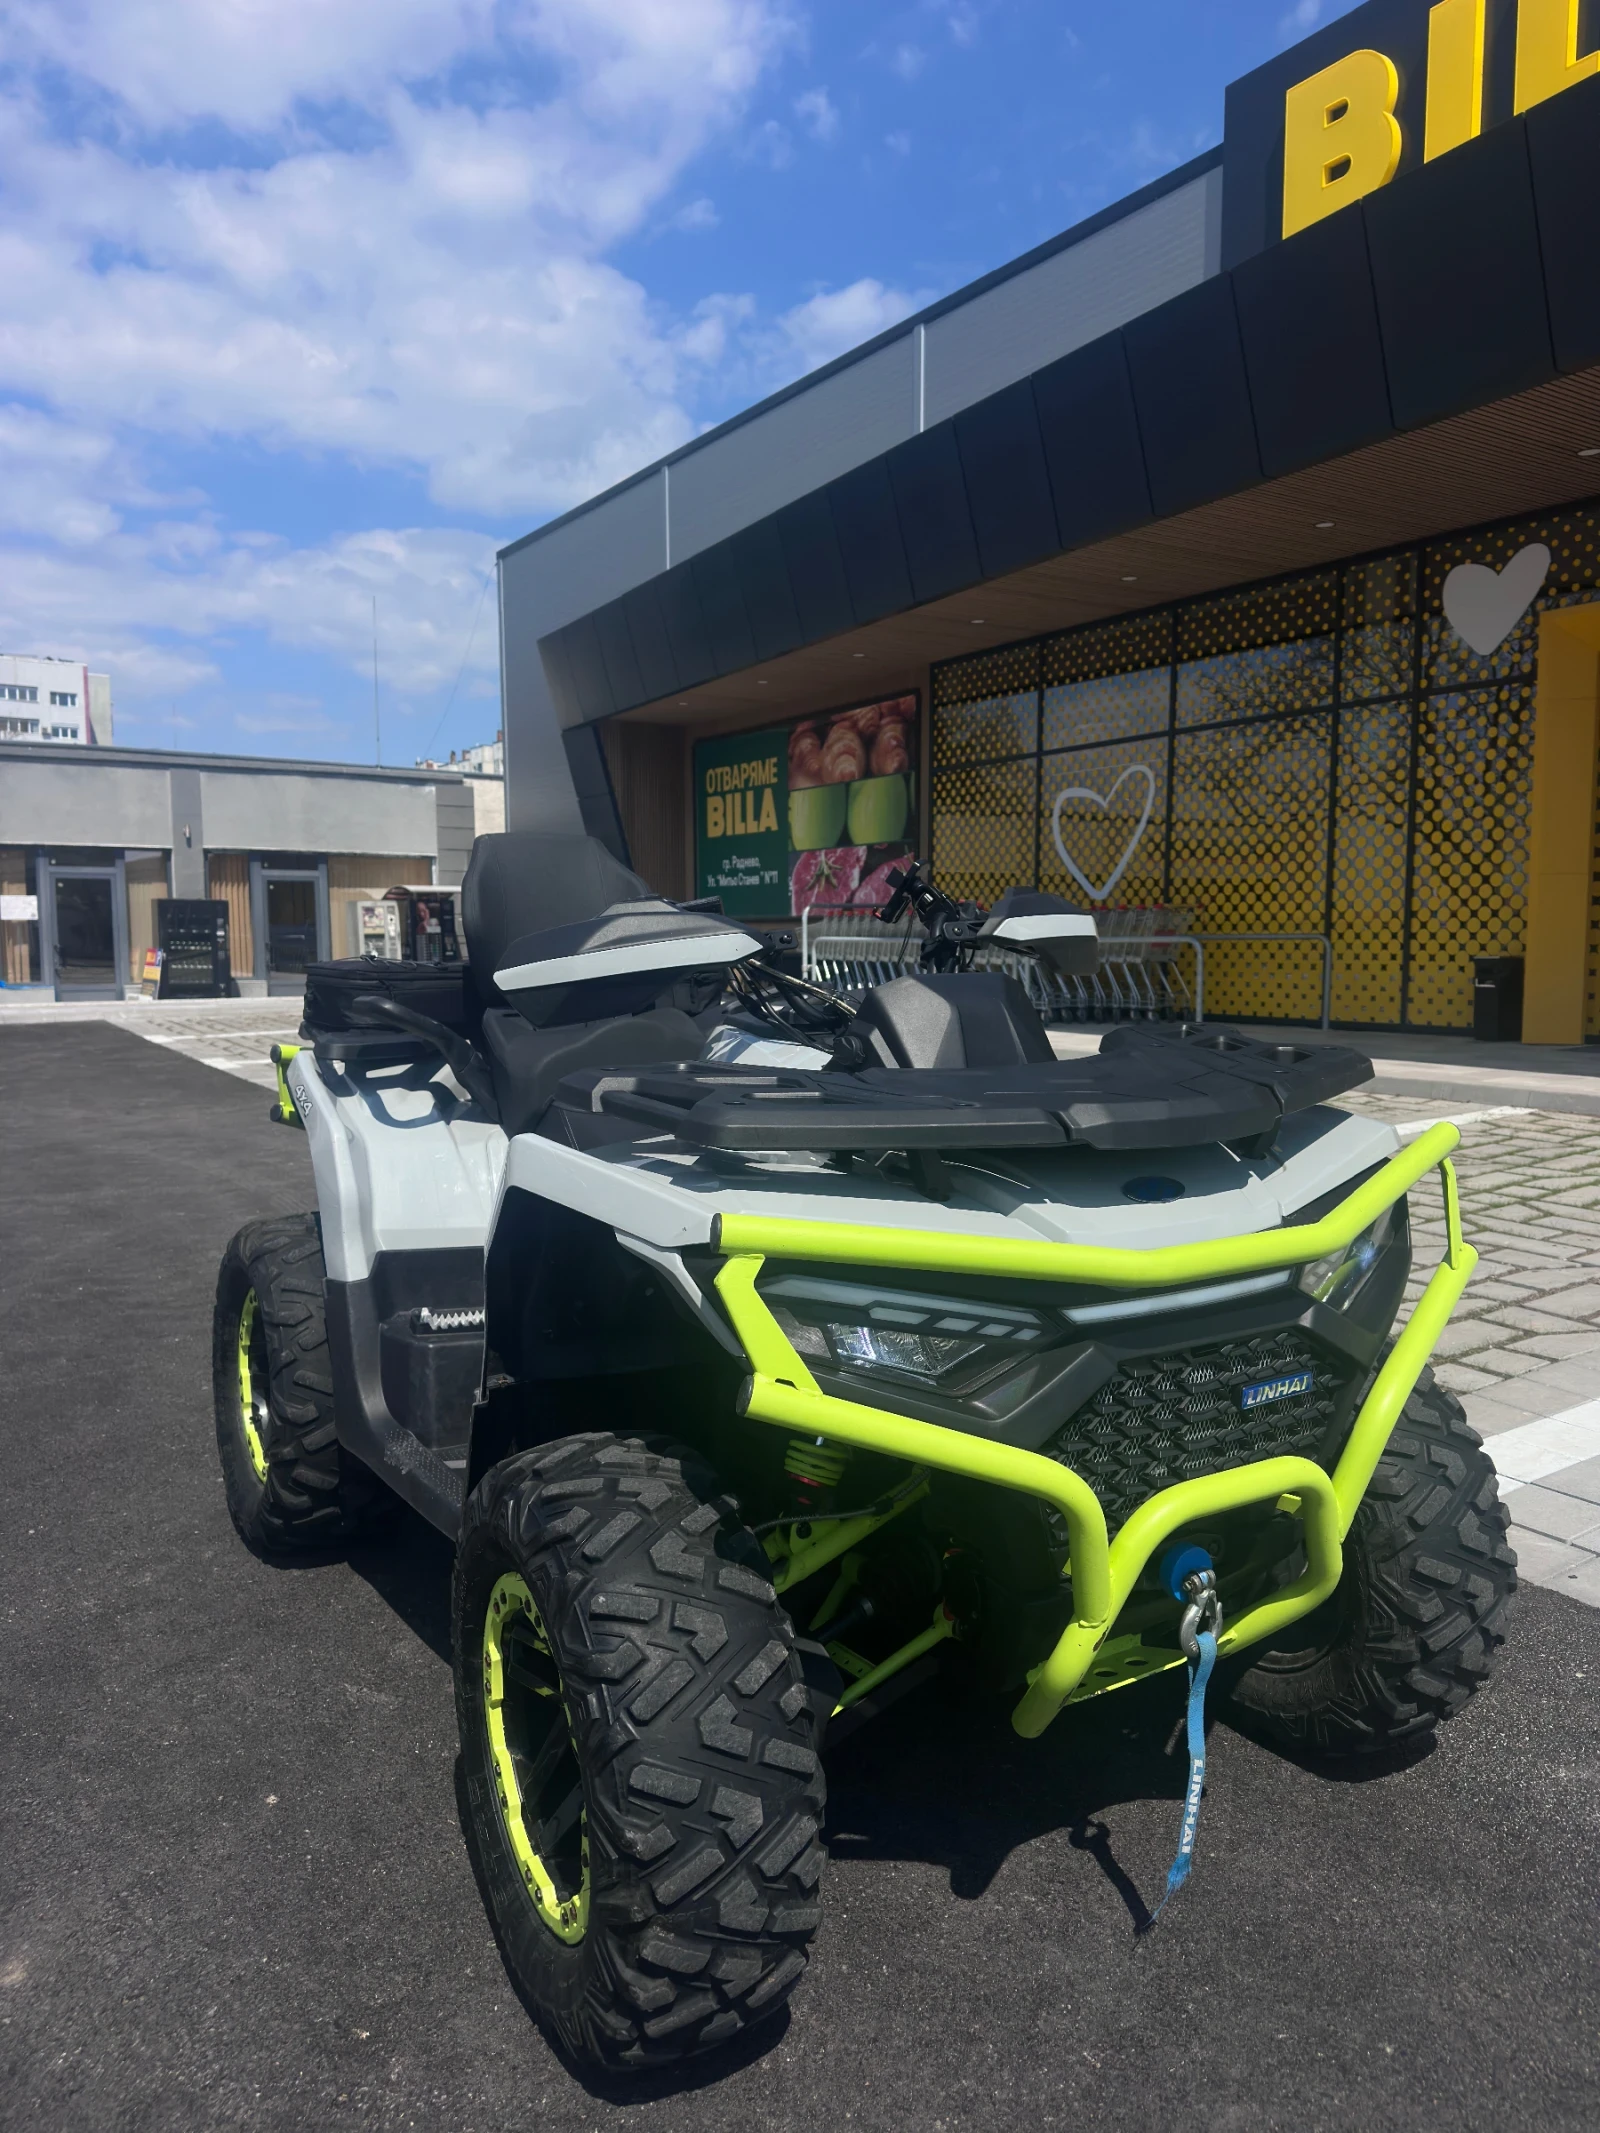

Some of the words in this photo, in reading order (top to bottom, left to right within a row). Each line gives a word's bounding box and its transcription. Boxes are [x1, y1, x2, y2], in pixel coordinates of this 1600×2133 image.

[706, 757, 778, 794] ОТВАРЯМЕ
[707, 787, 779, 838] BILLA
[1246, 1375, 1309, 1405] LINHAI
[1181, 1759, 1204, 1854] LINHAI
